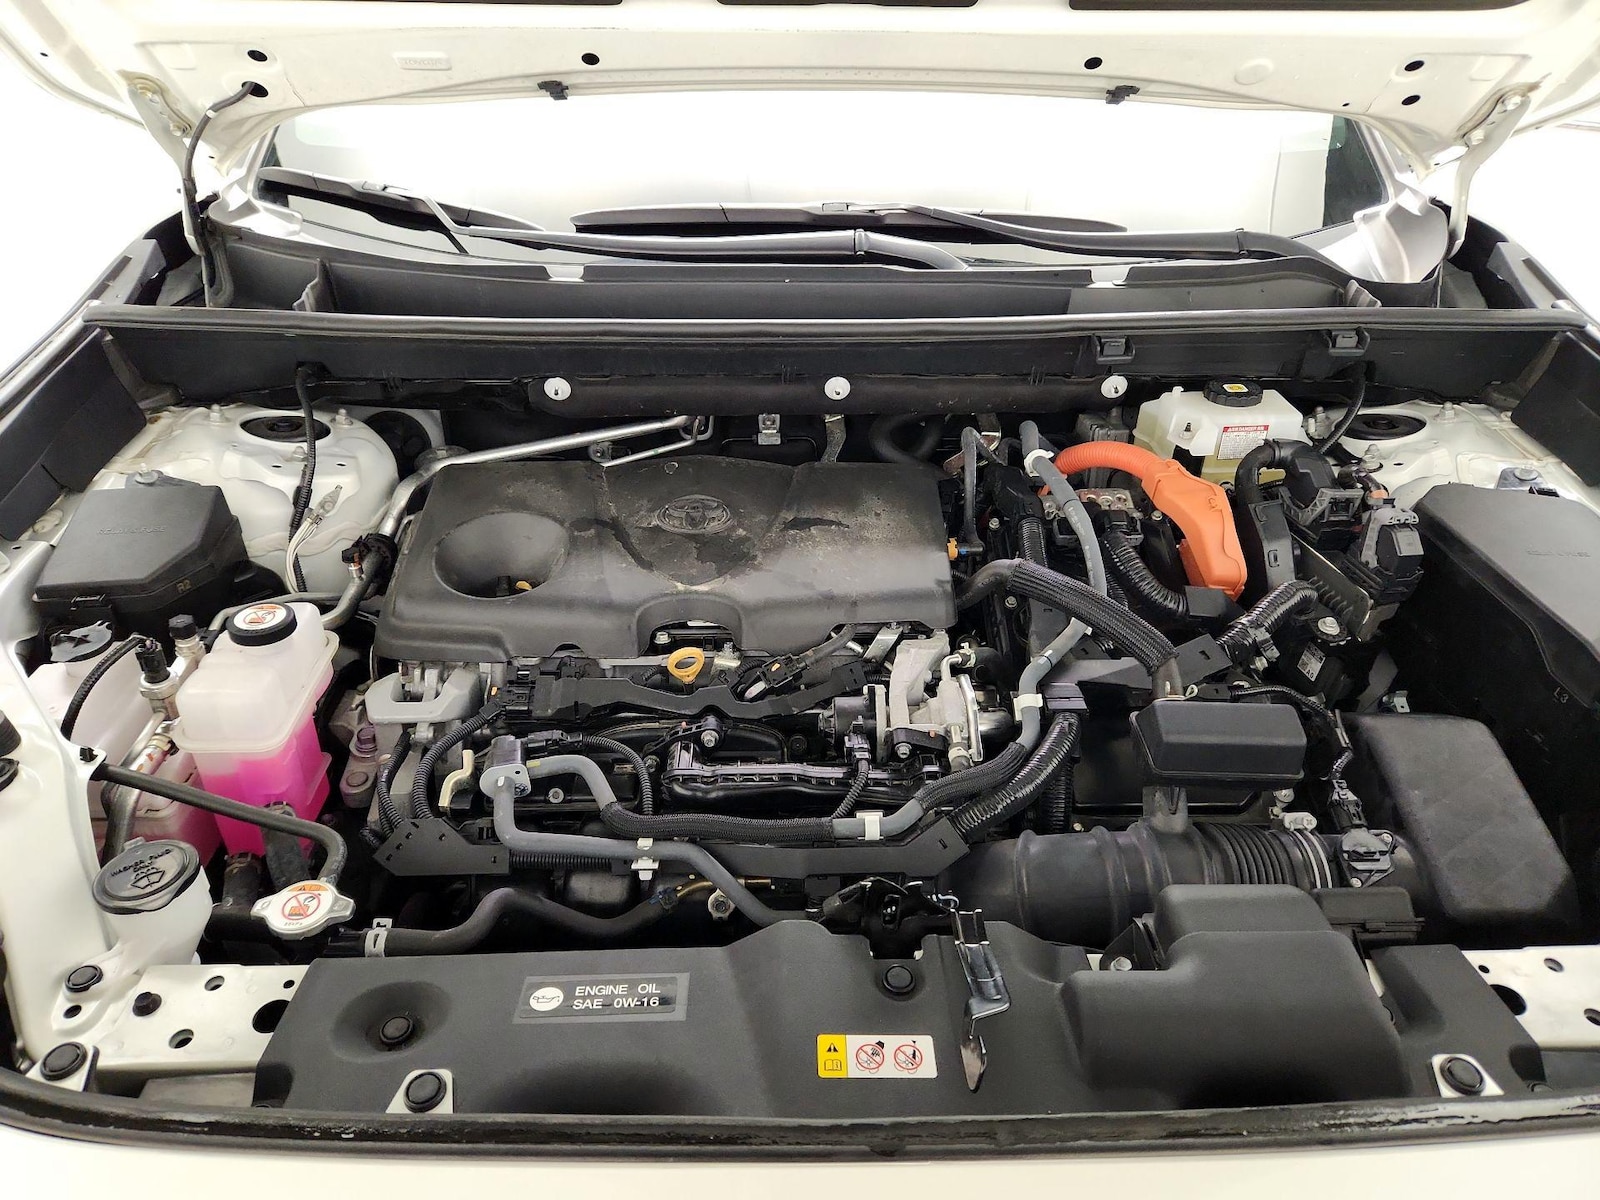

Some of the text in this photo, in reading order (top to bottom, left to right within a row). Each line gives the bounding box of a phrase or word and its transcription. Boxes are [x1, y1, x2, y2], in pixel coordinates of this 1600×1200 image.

[176, 580, 192, 594] R2
[110, 848, 172, 877] WASHER FLUID
[132, 860, 154, 873] ONLY
[575, 983, 661, 996] ENGINE OIL
[572, 996, 660, 1010] SAE 0W-16
